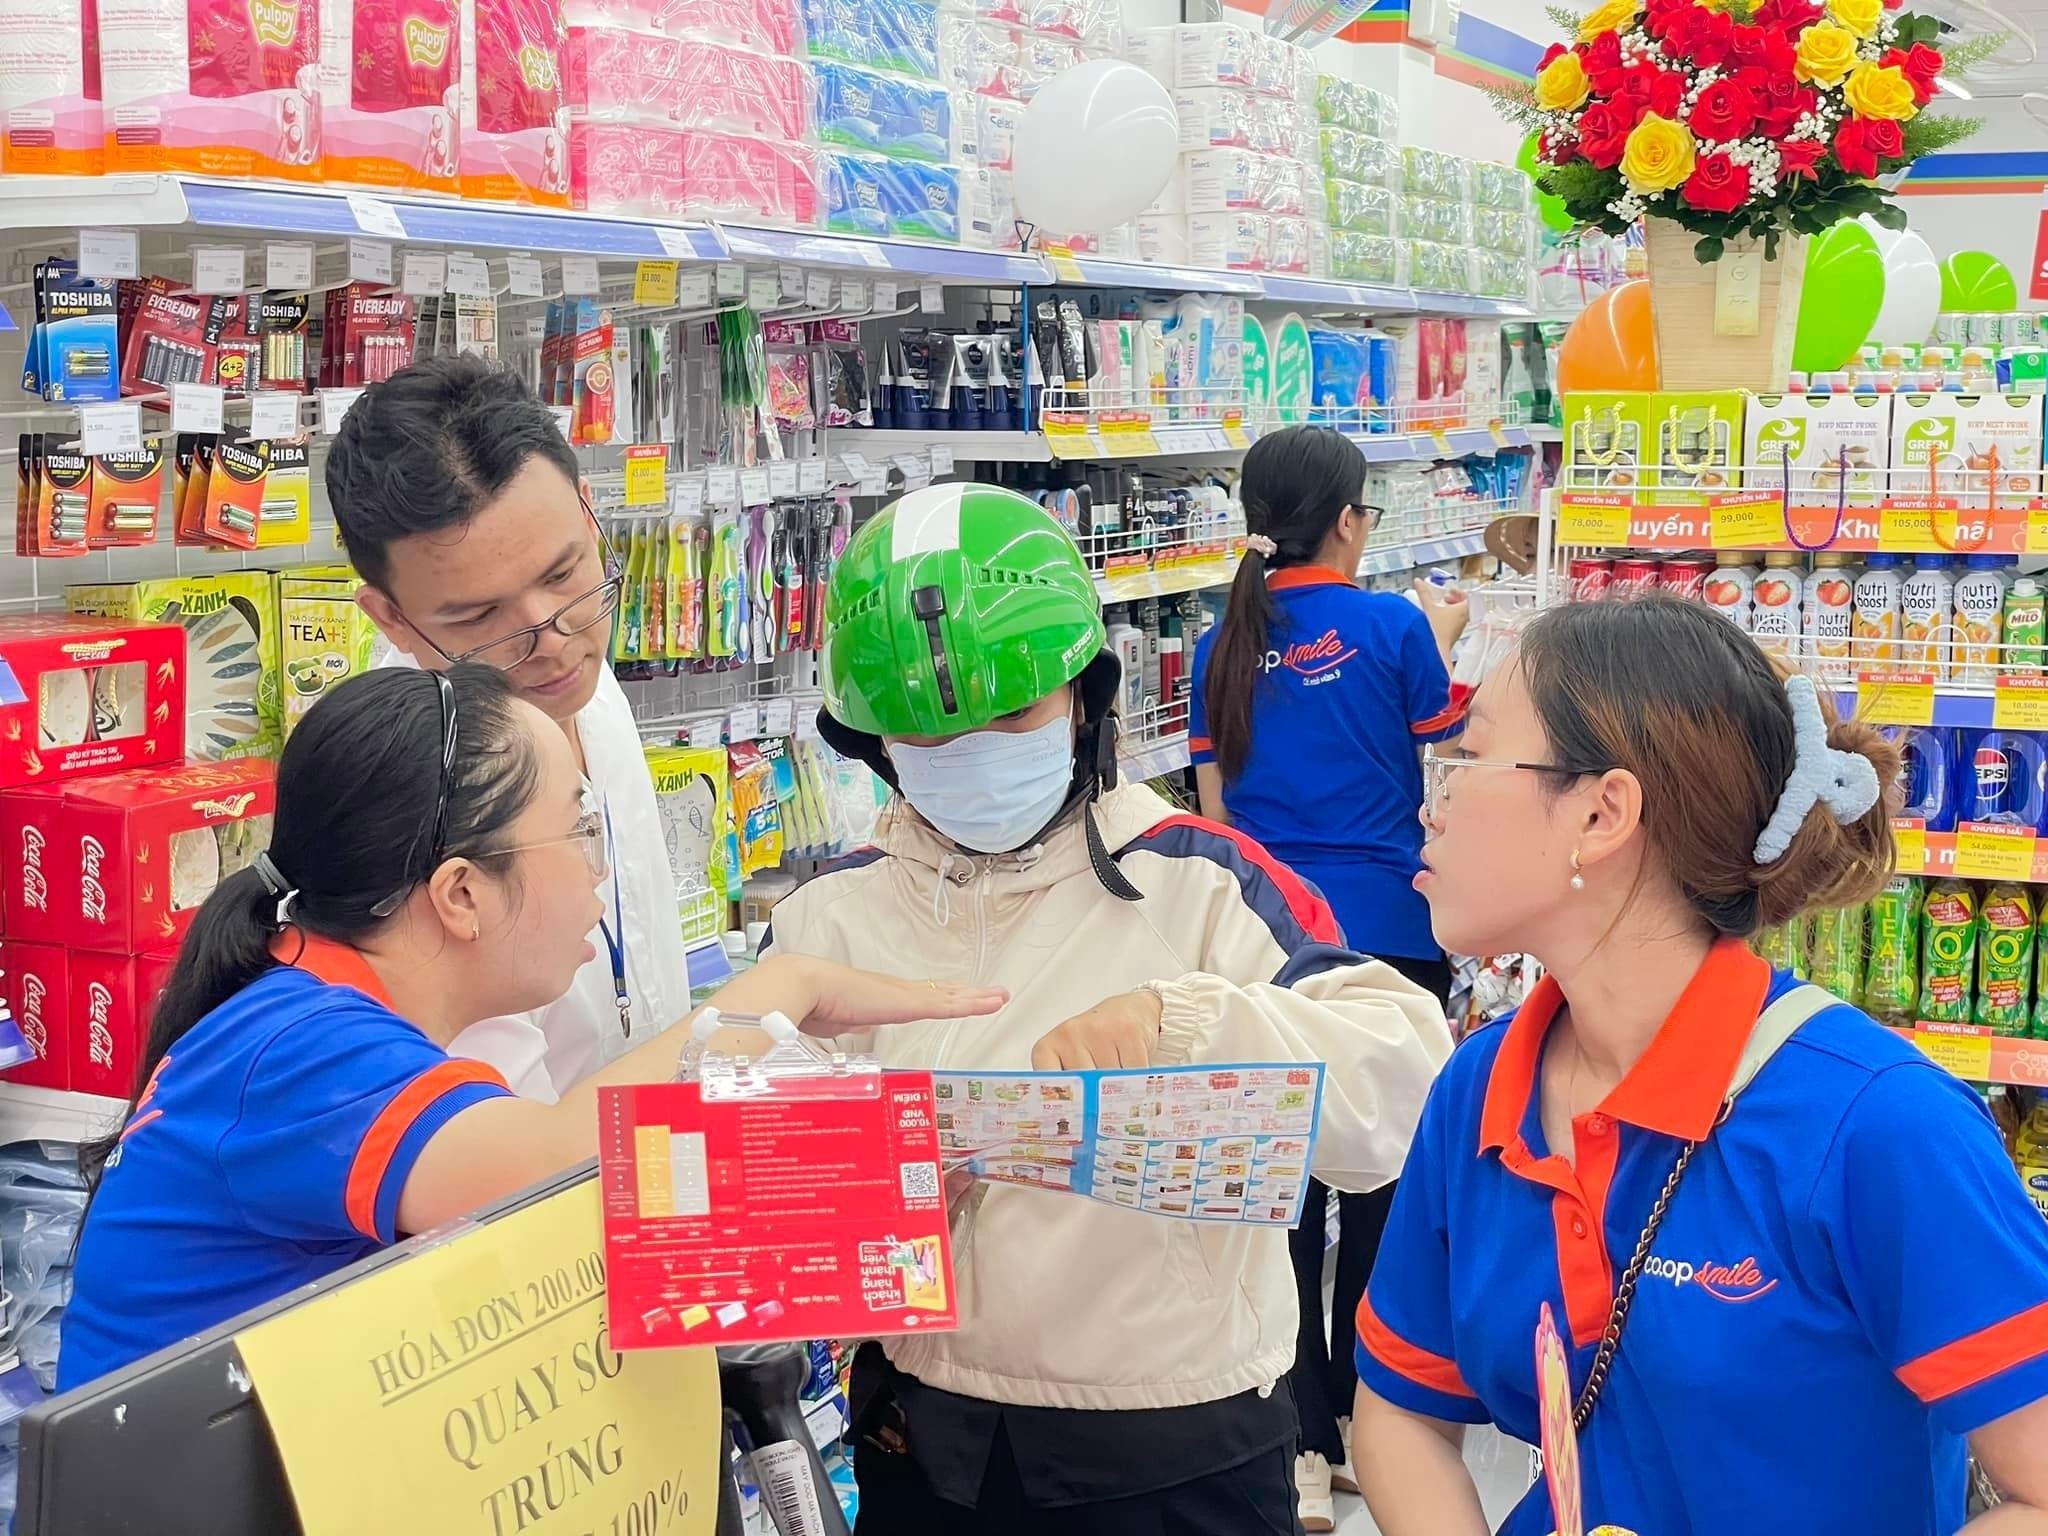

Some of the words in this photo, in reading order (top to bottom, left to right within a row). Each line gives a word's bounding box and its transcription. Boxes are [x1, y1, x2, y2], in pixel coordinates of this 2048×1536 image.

[255, 4, 295, 28] Pulppy
[410, 25, 447, 49] Pulppy
[50, 292, 112, 306] TOSHIBA
[147, 295, 200, 320] EVEREADY
[262, 306, 301, 318] OSHIBA
[353, 300, 405, 316] EVEREADY
[221, 361, 244, 373] 4+2
[222, 445, 263, 470] TOSHIBA
[271, 449, 304, 461] HIBA
[1907, 451, 1928, 461] BIR
[47, 455, 86, 469] TOSHIBA
[1571, 518, 1603, 528] 78,000
[1721, 512, 1754, 523] 99,000
[1893, 519, 1932, 529] 105,000
[1627, 513, 1694, 541] uyến
[1837, 519, 1879, 539] Khu
[1857, 582, 1887, 595] nutri
[1904, 582, 1936, 596] nutri
[1962, 582, 1997, 597] nutri
[182, 589, 228, 613] XANH
[1857, 596, 1888, 608] boost
[1903, 596, 1936, 609] boost
[1962, 597, 1998, 609] boost
[1818, 612, 1848, 624] nutri
[2011, 611, 2039, 624] MILO
[1818, 625, 1848, 637] boost
[1282, 629, 1343, 666] smile
[1869, 674, 1904, 682] KHYẾN
[1976, 768, 2008, 779] EPSI
[656, 768, 693, 793] XANH
[899, 1119, 930, 1128] 10.000
[2031, 1177, 2048, 1187] Sim
[1693, 1257, 1762, 1287] smile
[863, 1289, 901, 1301] khách
[368, 1330, 452, 1396] HÓA
[452, 1290, 525, 1355] ĐƠN
[527, 1251, 605, 1318] 200.00
[444, 1356, 563, 1471] QUAY
[572, 1313, 623, 1393] SỐ
[480, 1422, 625, 1536] TRÚNG
